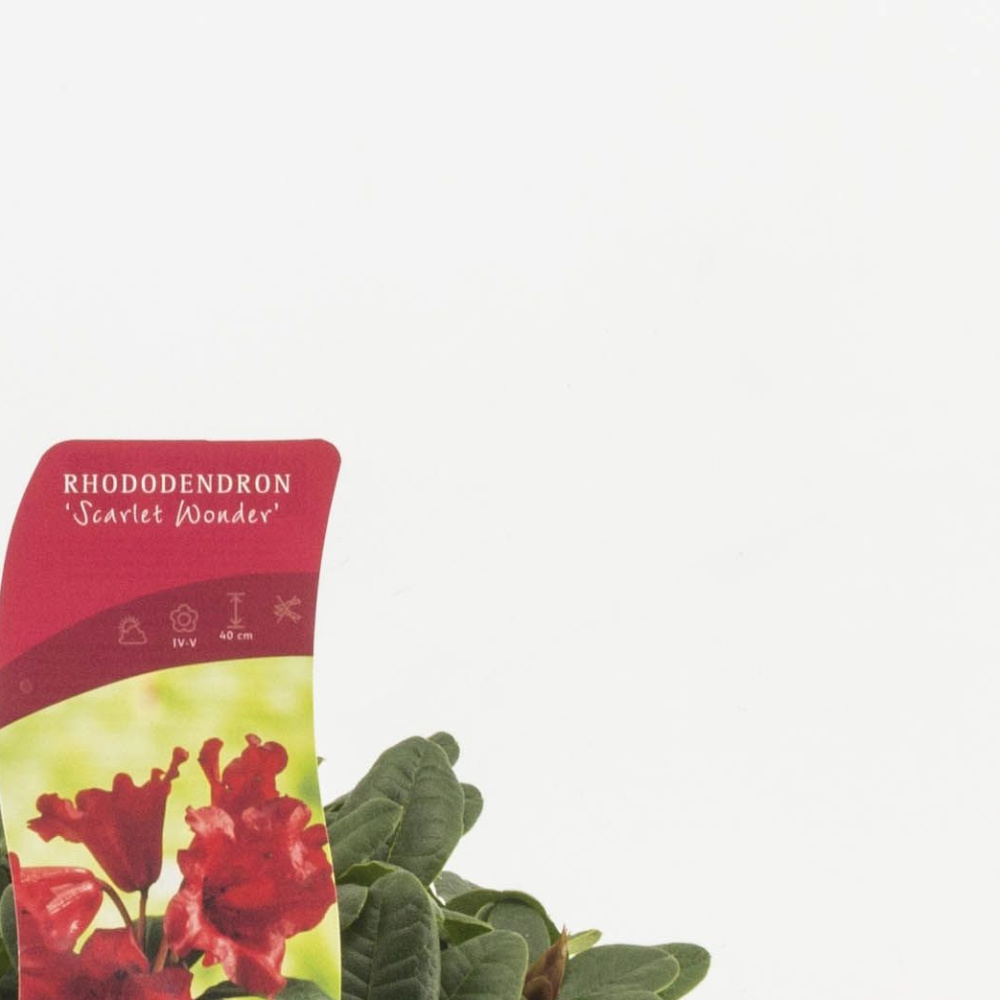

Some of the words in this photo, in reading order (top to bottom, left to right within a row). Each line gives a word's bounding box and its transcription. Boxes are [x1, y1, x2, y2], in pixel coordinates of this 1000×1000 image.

[63, 473, 292, 494] RHODODENDRON
[219, 630, 234, 641] 40
[236, 632, 254, 641] cm
[172, 637, 198, 648] IV-V
